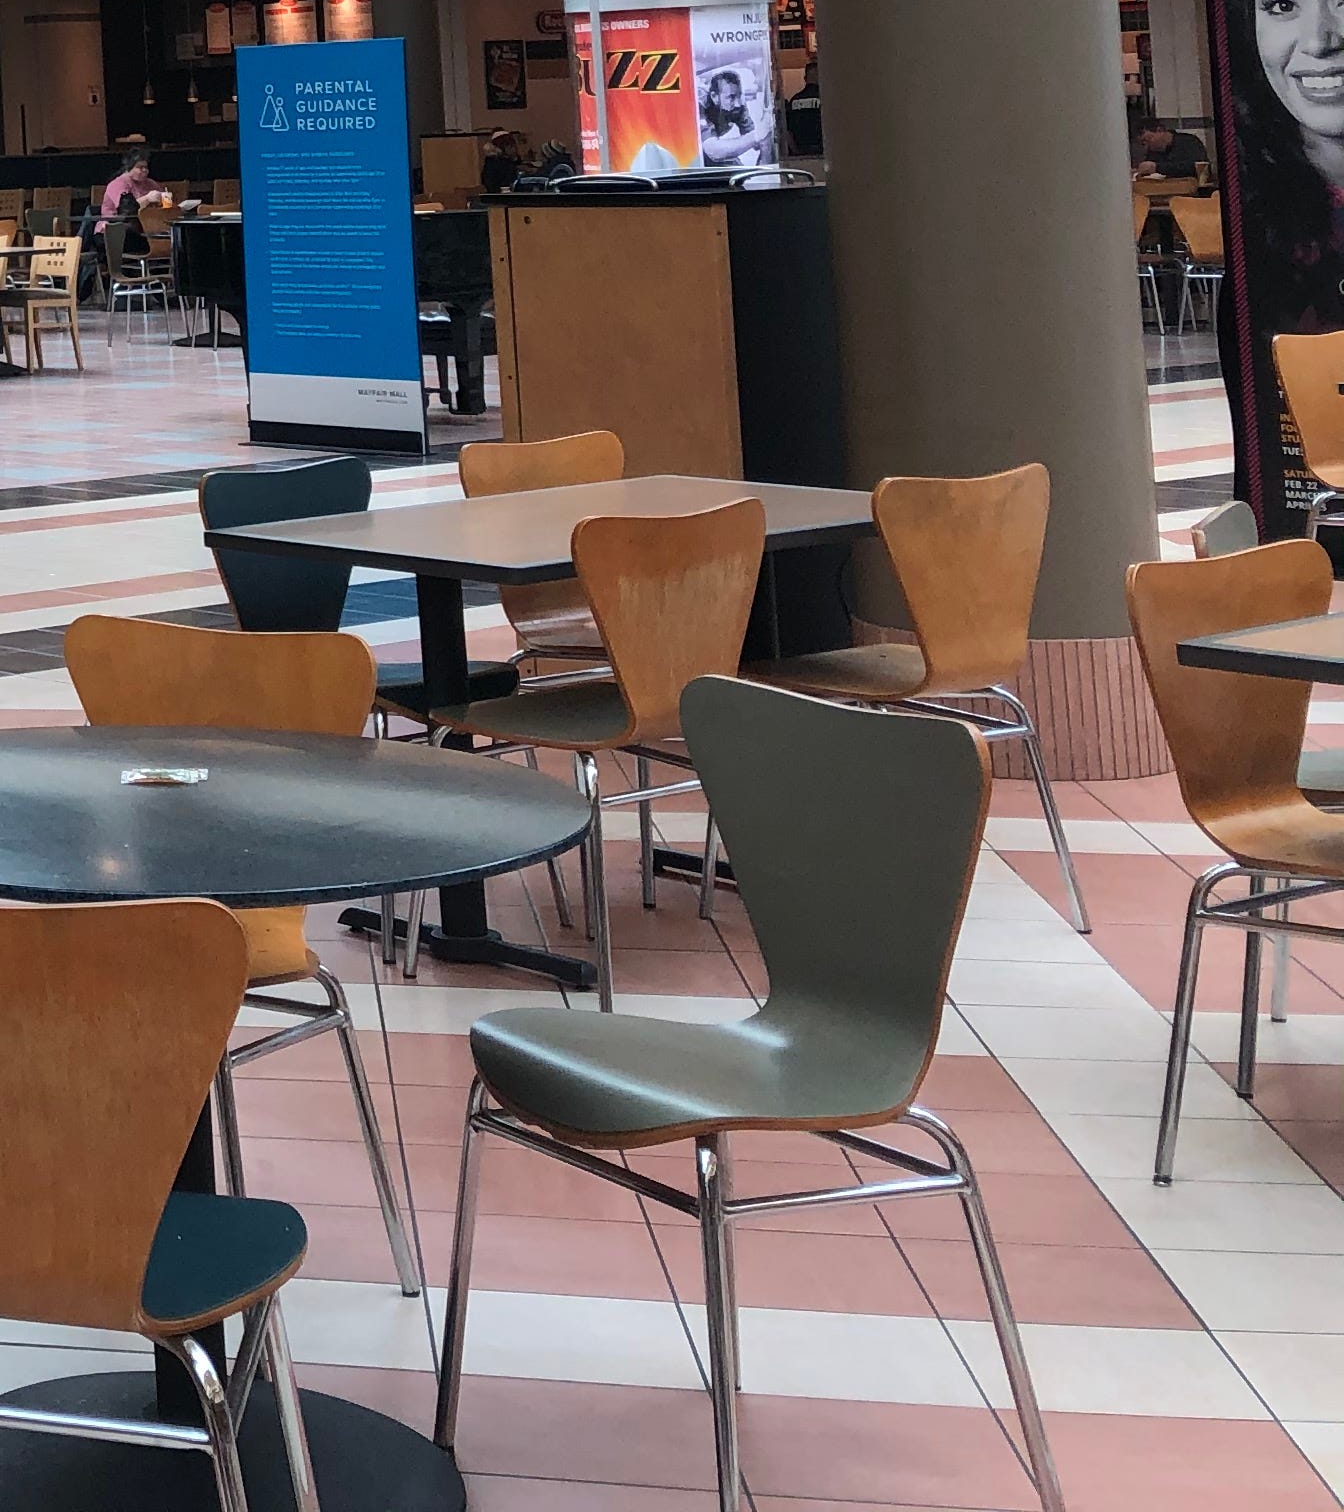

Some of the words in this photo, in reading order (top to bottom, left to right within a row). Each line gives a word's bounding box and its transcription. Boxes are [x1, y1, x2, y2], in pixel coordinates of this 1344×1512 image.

[610, 19, 650, 31] OWNERS
[295, 80, 373, 95] PARENTAL
[295, 97, 377, 113] GUIDANCE
[296, 116, 376, 131] REQUIRED
[1284, 480, 1304, 489] FEB.
